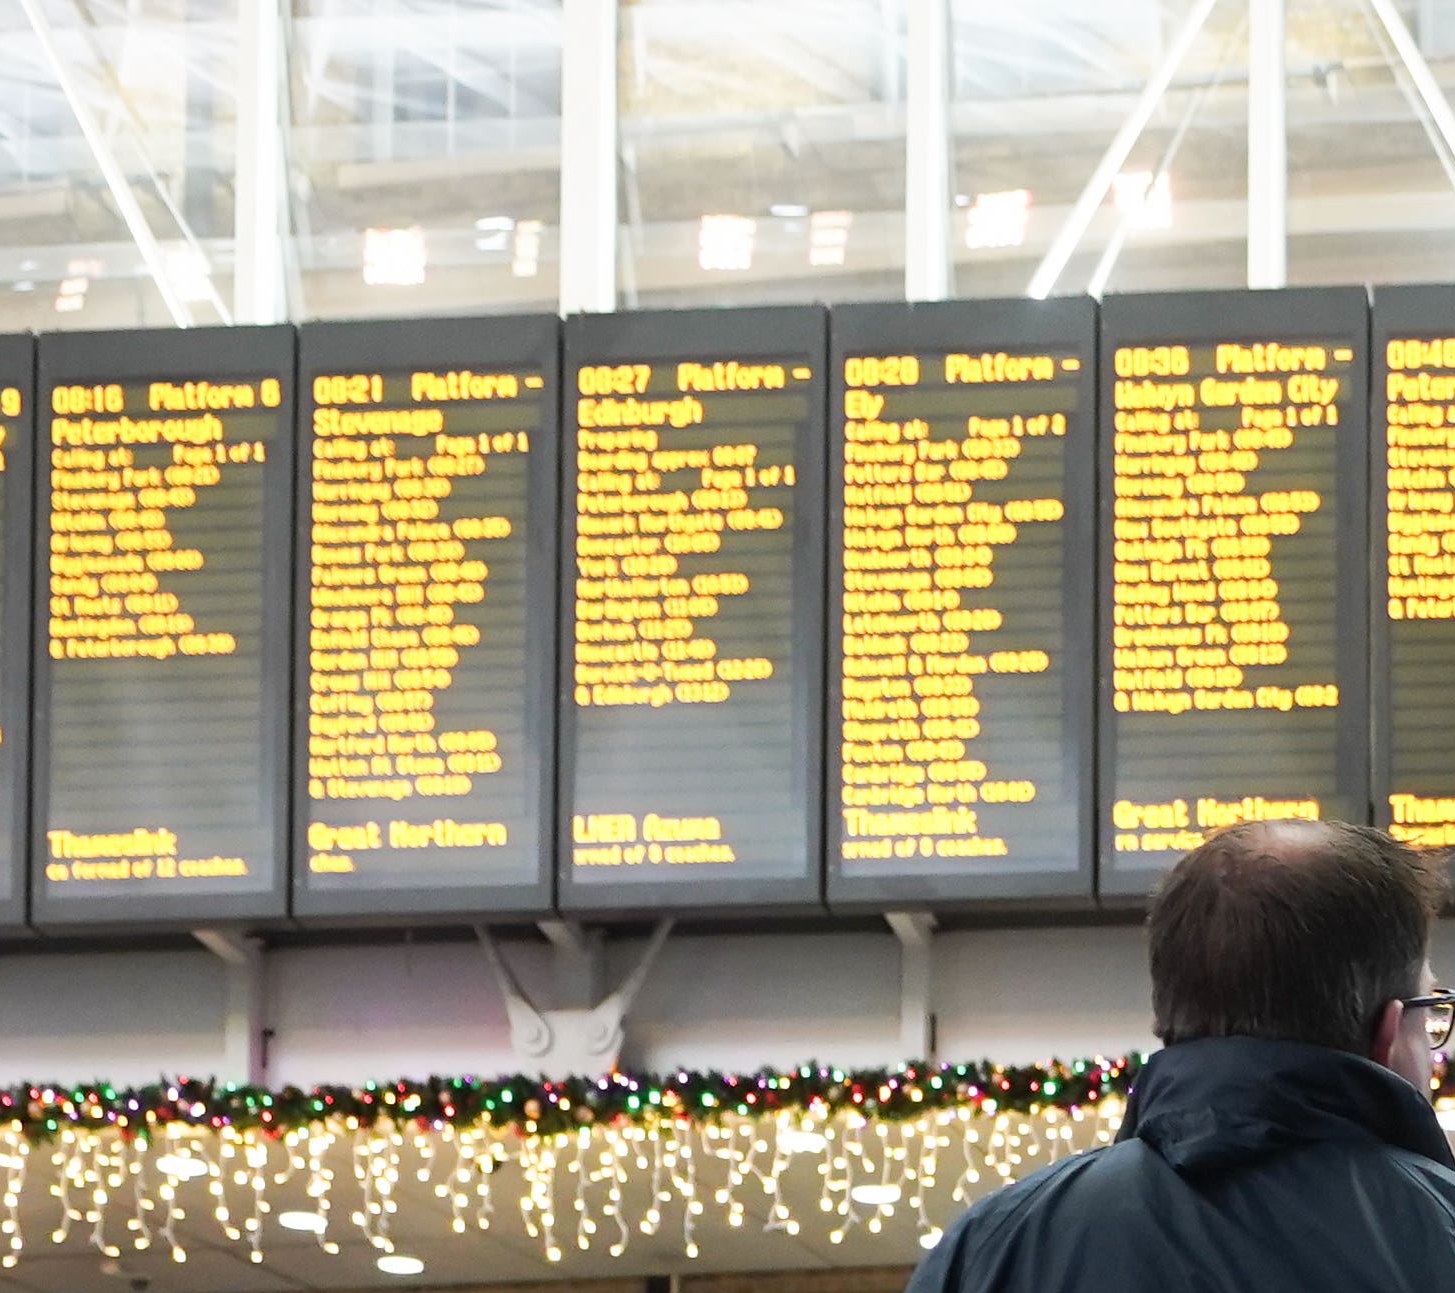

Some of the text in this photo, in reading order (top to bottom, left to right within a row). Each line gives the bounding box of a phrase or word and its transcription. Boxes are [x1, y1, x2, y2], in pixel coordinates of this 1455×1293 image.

[944, 352, 1056, 383] Platform
[1213, 342, 1328, 374] Platform
[410, 371, 519, 401] Platform
[676, 361, 786, 392] Platform
[1114, 374, 1340, 410] Welwyn Garden City
[148, 381, 255, 411] Platform
[577, 395, 705, 428] Edinburgh
[845, 389, 887, 422] Ely
[51, 413, 223, 446] Peterborough
[313, 408, 444, 436] Stevenage
[844, 806, 977, 837] Thameslink
[1113, 797, 1320, 831] Great Northern
[47, 828, 176, 858] Thameslink
[307, 820, 503, 849] Great Northern
